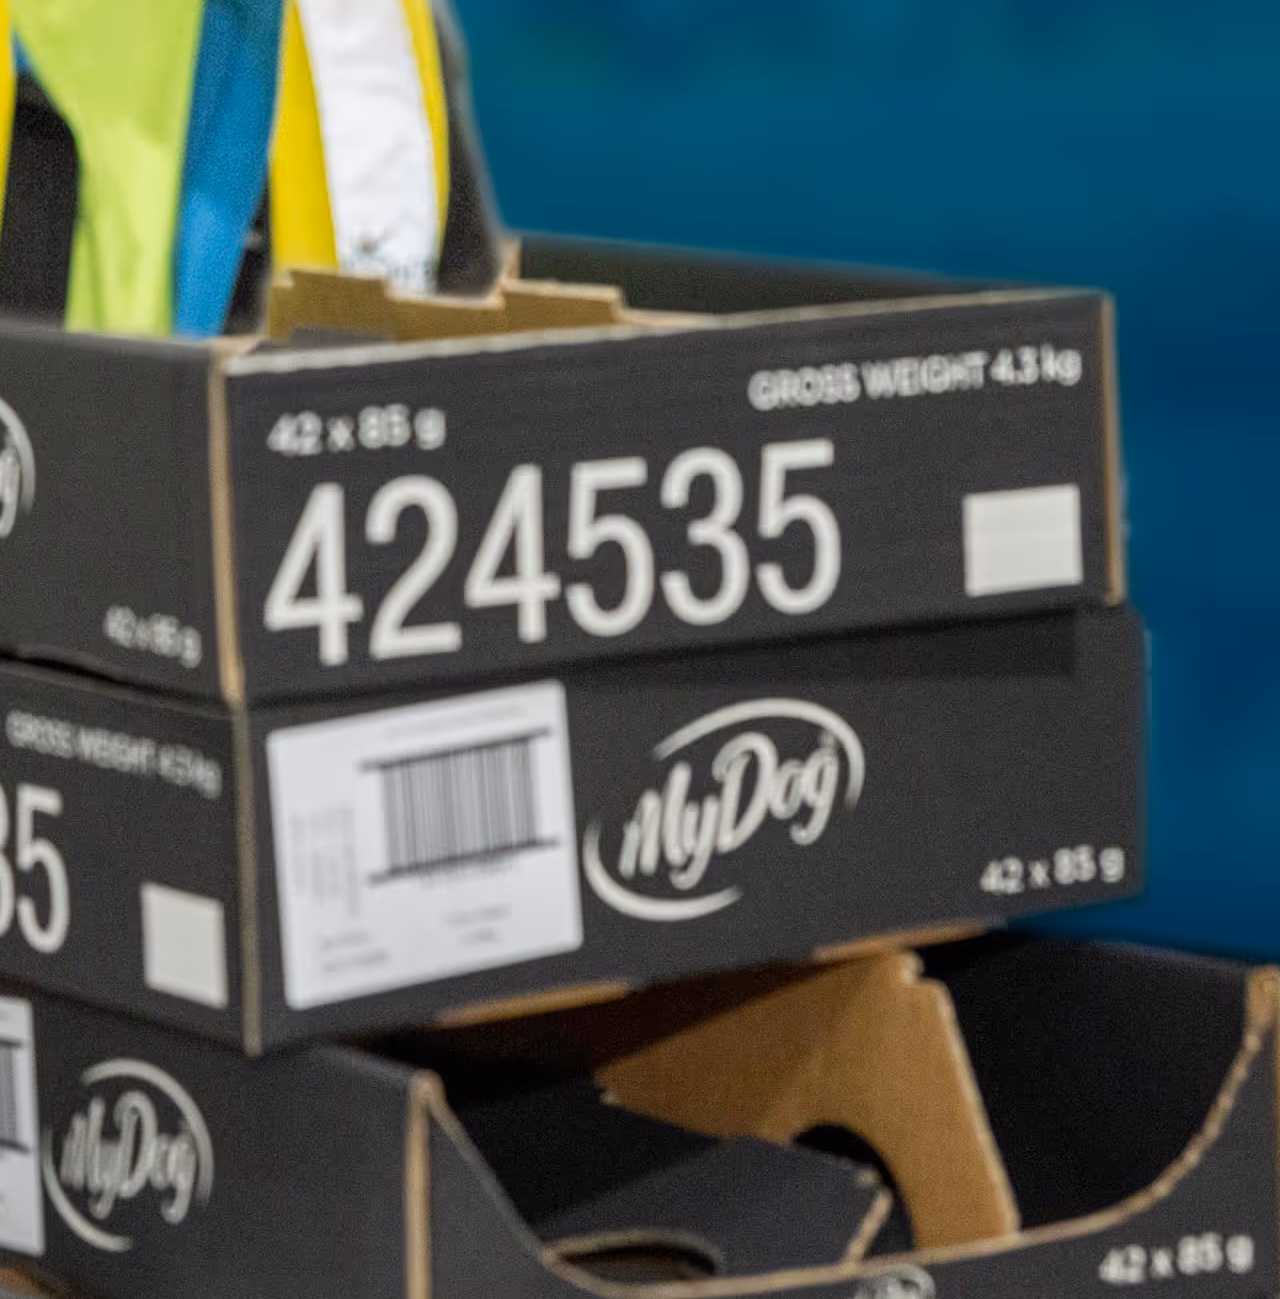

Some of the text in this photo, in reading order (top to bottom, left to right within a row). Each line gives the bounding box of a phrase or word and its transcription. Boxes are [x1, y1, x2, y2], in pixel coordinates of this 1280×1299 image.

[748, 363, 861, 412] GROSS
[861, 350, 987, 399] WEIGHT
[266, 403, 447, 457] 42 x 85 g
[263, 438, 842, 666] 424535
[618, 730, 840, 890] MyDog
[980, 845, 1126, 895] 42 x 85 g
[1098, 1243, 1147, 1285] 42
[1176, 1232, 1223, 1276] 85
[1224, 1234, 1256, 1275] g
